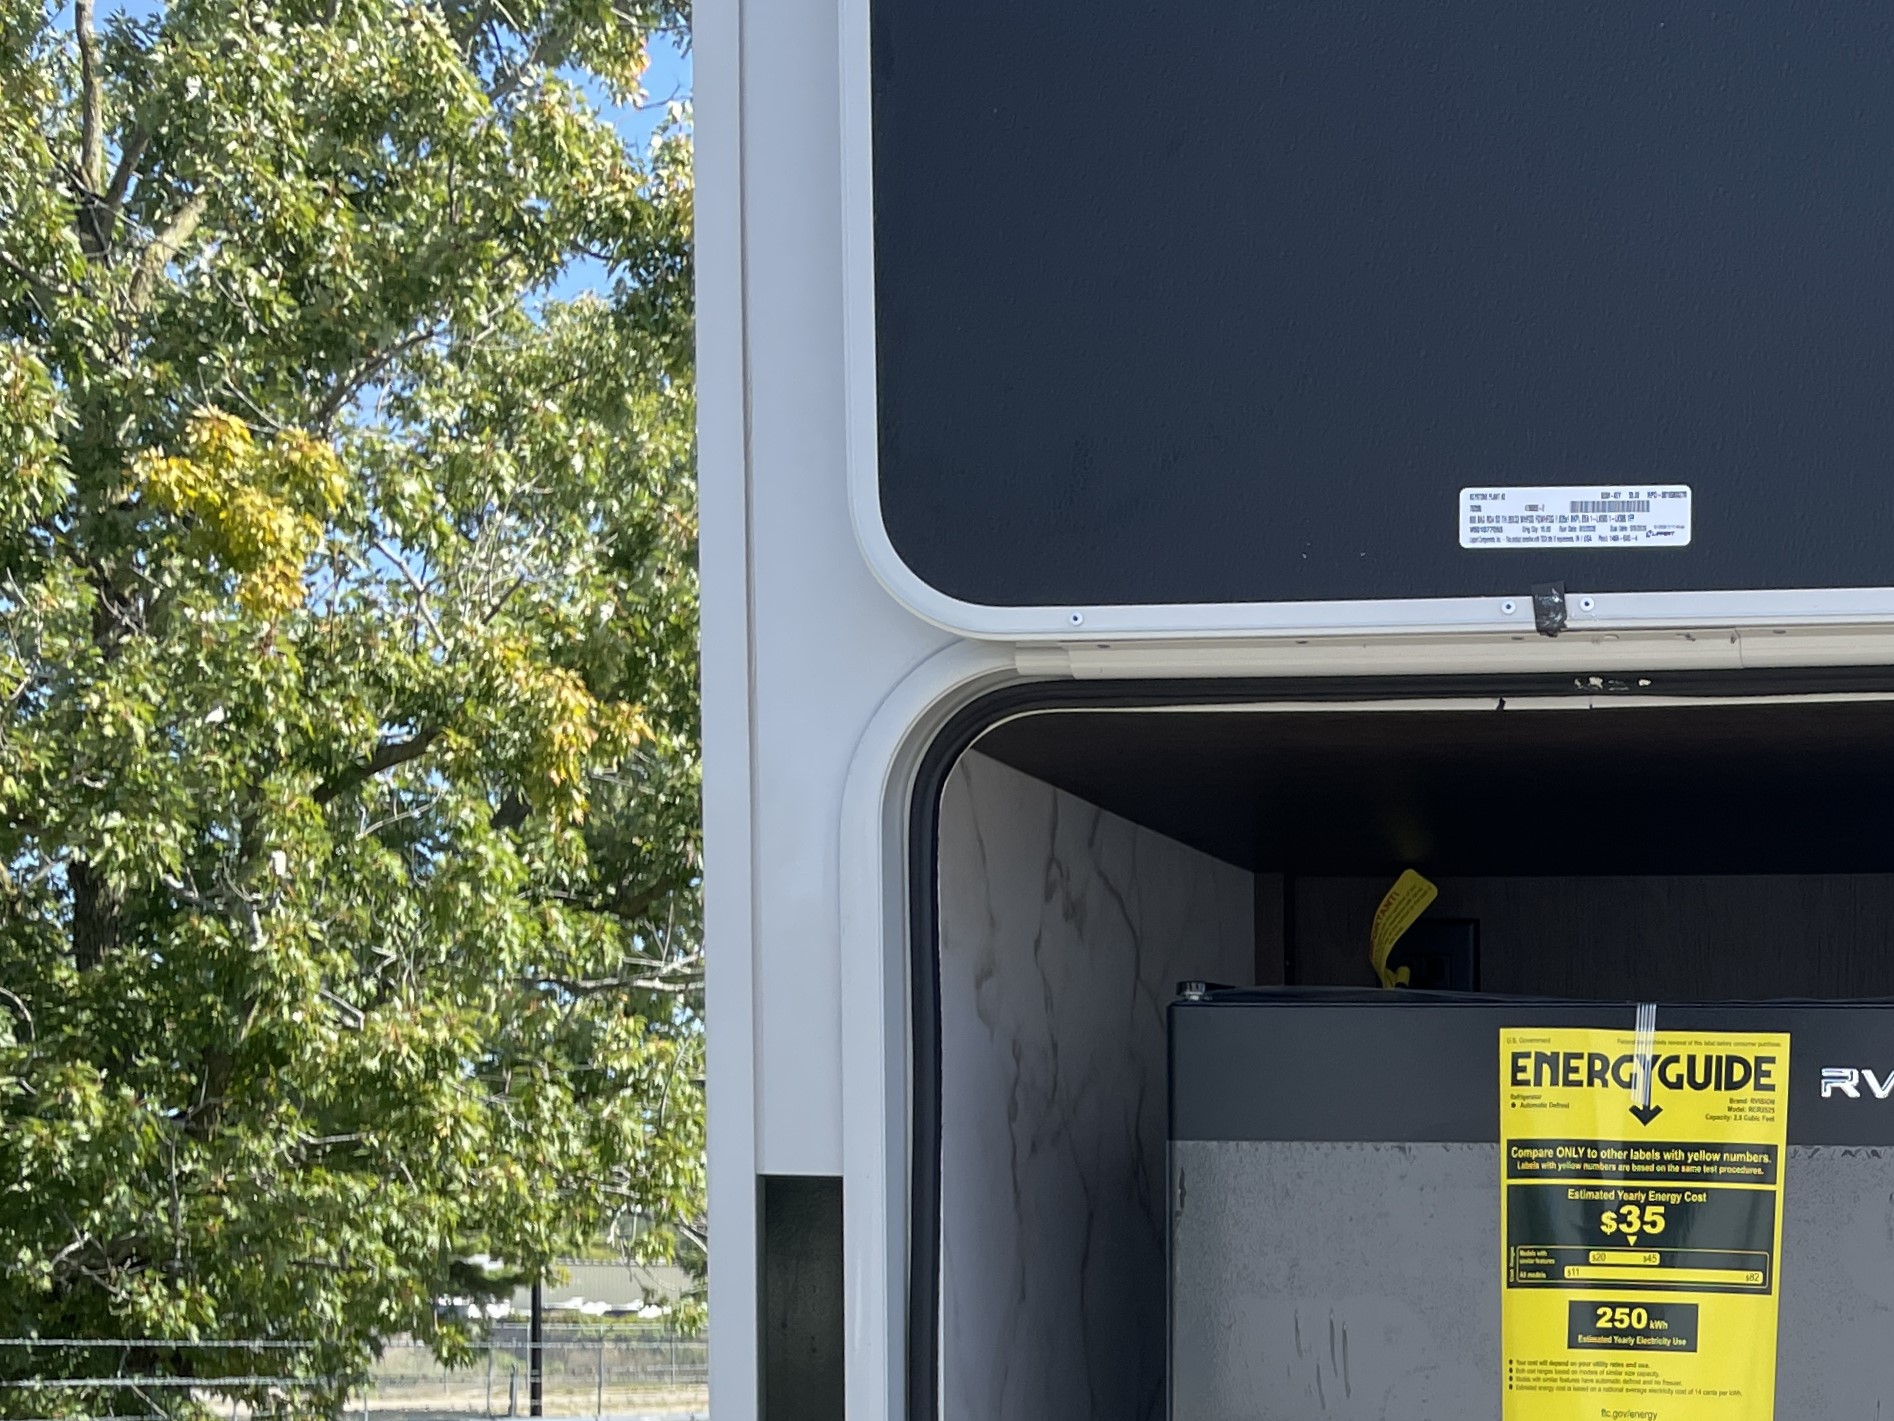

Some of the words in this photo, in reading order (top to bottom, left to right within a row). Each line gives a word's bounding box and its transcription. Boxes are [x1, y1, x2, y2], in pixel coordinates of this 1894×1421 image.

[1511, 1146, 1553, 1160] Compare
[1556, 1146, 1586, 1159] ONLY
[1587, 1147, 1598, 1159] to
[1600, 1148, 1628, 1160] other
[1630, 1148, 1660, 1161] labels
[1662, 1149, 1685, 1161] with
[1687, 1149, 1720, 1163] yellow
[1723, 1151, 1772, 1164] numbers.
[1517, 1161, 1539, 1170] Labels
[1541, 1161, 1556, 1170] with
[1558, 1161, 1581, 1171] yellow
[1583, 1162, 1616, 1171] numbers
[1618, 1164, 1630, 1172] are
[1631, 1163, 1654, 1172] based
[1667, 1164, 1679, 1172] the
[1681, 1165, 1701, 1173] same
[1703, 1164, 1717, 1173] test
[1719, 1165, 1764, 1175] procedures.
[1567, 1188, 1615, 1200] Estimated
[1617, 1190, 1646, 1203] Yearly
[1648, 1190, 1682, 1204] Energy
[1684, 1191, 1707, 1202] Cost
[1600, 1205, 1666, 1235] $35
[1592, 1252, 1606, 1262] $20
[1643, 1254, 1657, 1263] $45
[1567, 1267, 1580, 1277] $11
[1745, 1273, 1759, 1283] $82
[1595, 1306, 1648, 1329] 250
[1649, 1320, 1668, 1330] kWh
[1578, 1334, 1612, 1344] Estimated
[1613, 1335, 1635, 1346] Yearly
[1636, 1336, 1671, 1346] Electricity
[1672, 1337, 1687, 1346] Use
[1601, 1408, 1658, 1421] ftc.gov/energy
